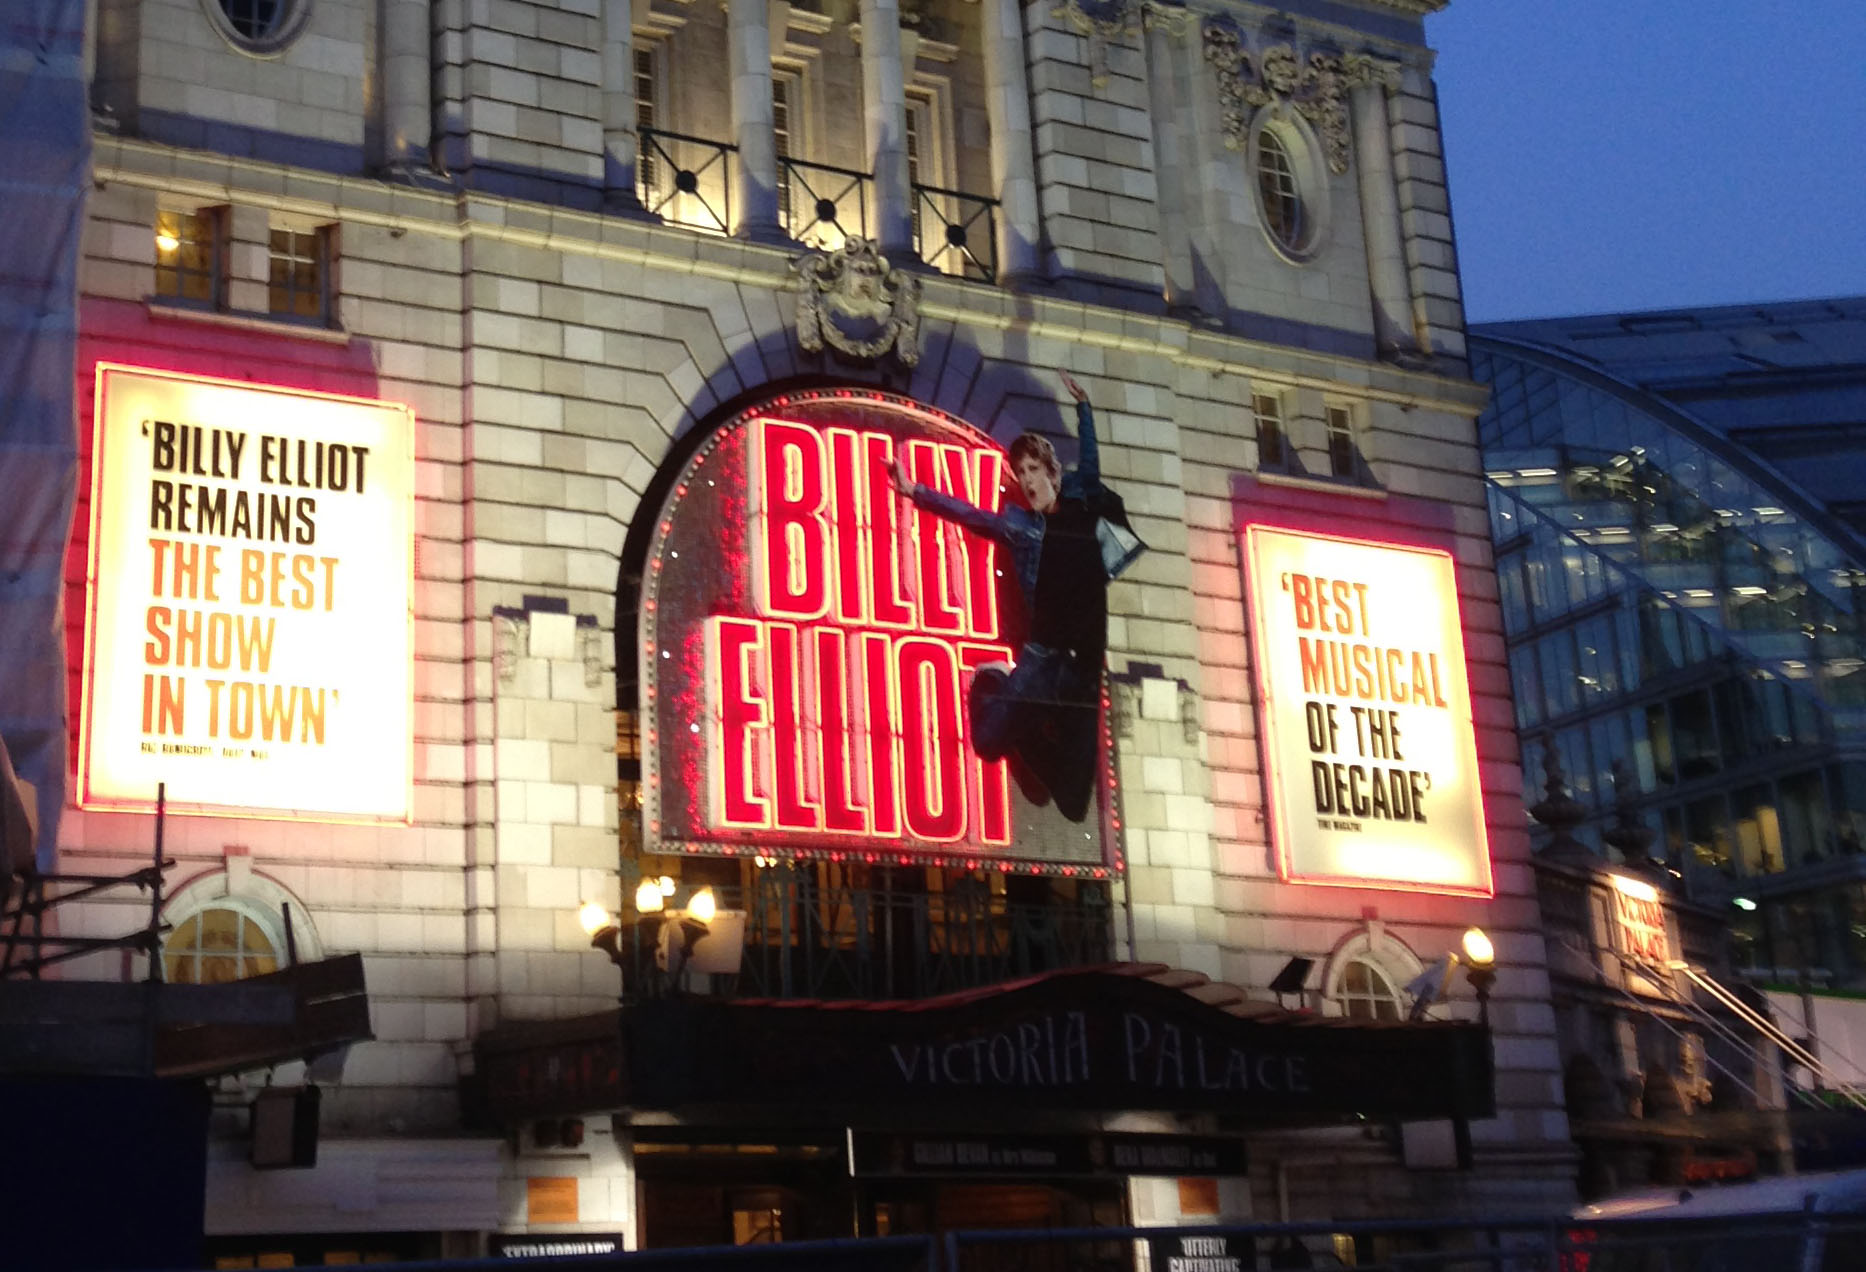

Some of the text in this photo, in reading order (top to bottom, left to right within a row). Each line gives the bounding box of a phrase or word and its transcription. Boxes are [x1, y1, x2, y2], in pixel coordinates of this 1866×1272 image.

[260, 434, 371, 494] ELLIOT
[150, 479, 316, 545] REMAINS
[755, 417, 1003, 640] BILLY
[149, 538, 339, 611] THE BEST
[144, 606, 275, 672] SHOW
[1298, 637, 1447, 708] MUSICAL
[141, 673, 185, 736] IN
[714, 615, 1012, 846] ELLIOT
[1306, 701, 1404, 761] OF THE
[890, 1010, 1311, 1093] VICTORIA PALACE
